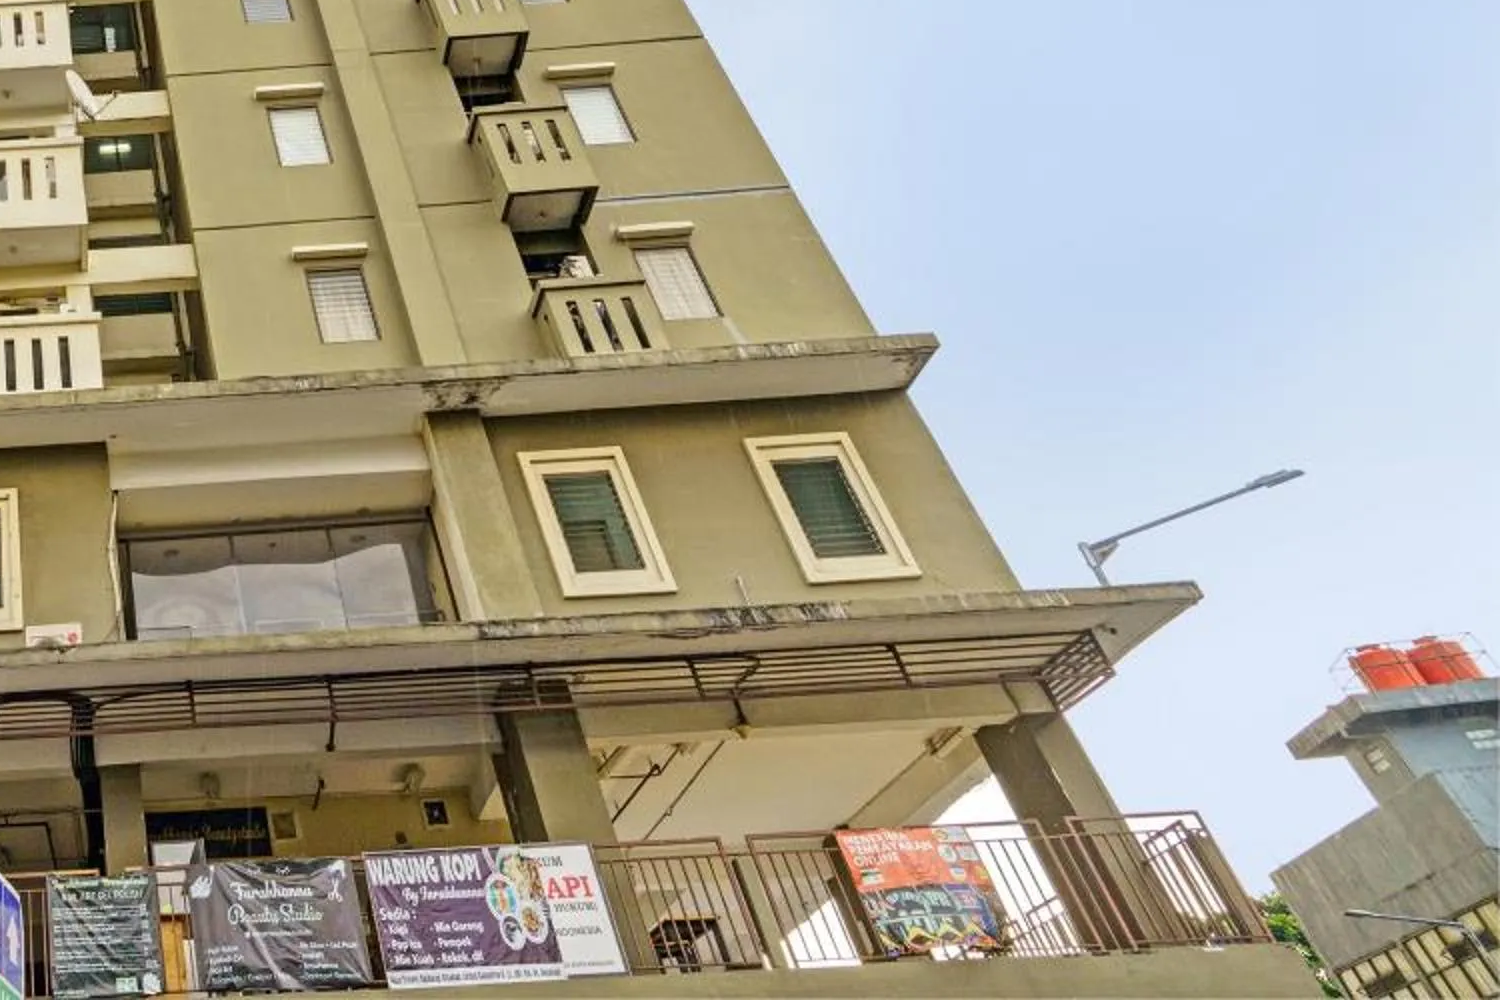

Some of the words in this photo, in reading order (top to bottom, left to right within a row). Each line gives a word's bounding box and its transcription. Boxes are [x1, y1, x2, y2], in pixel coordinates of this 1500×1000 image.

[366, 855, 440, 886] WARUNG
[440, 853, 483, 882] KOPI
[402, 887, 419, 906] By
[547, 875, 594, 899] API
[279, 902, 324, 923] Studio
[379, 907, 410, 921] Sedia
